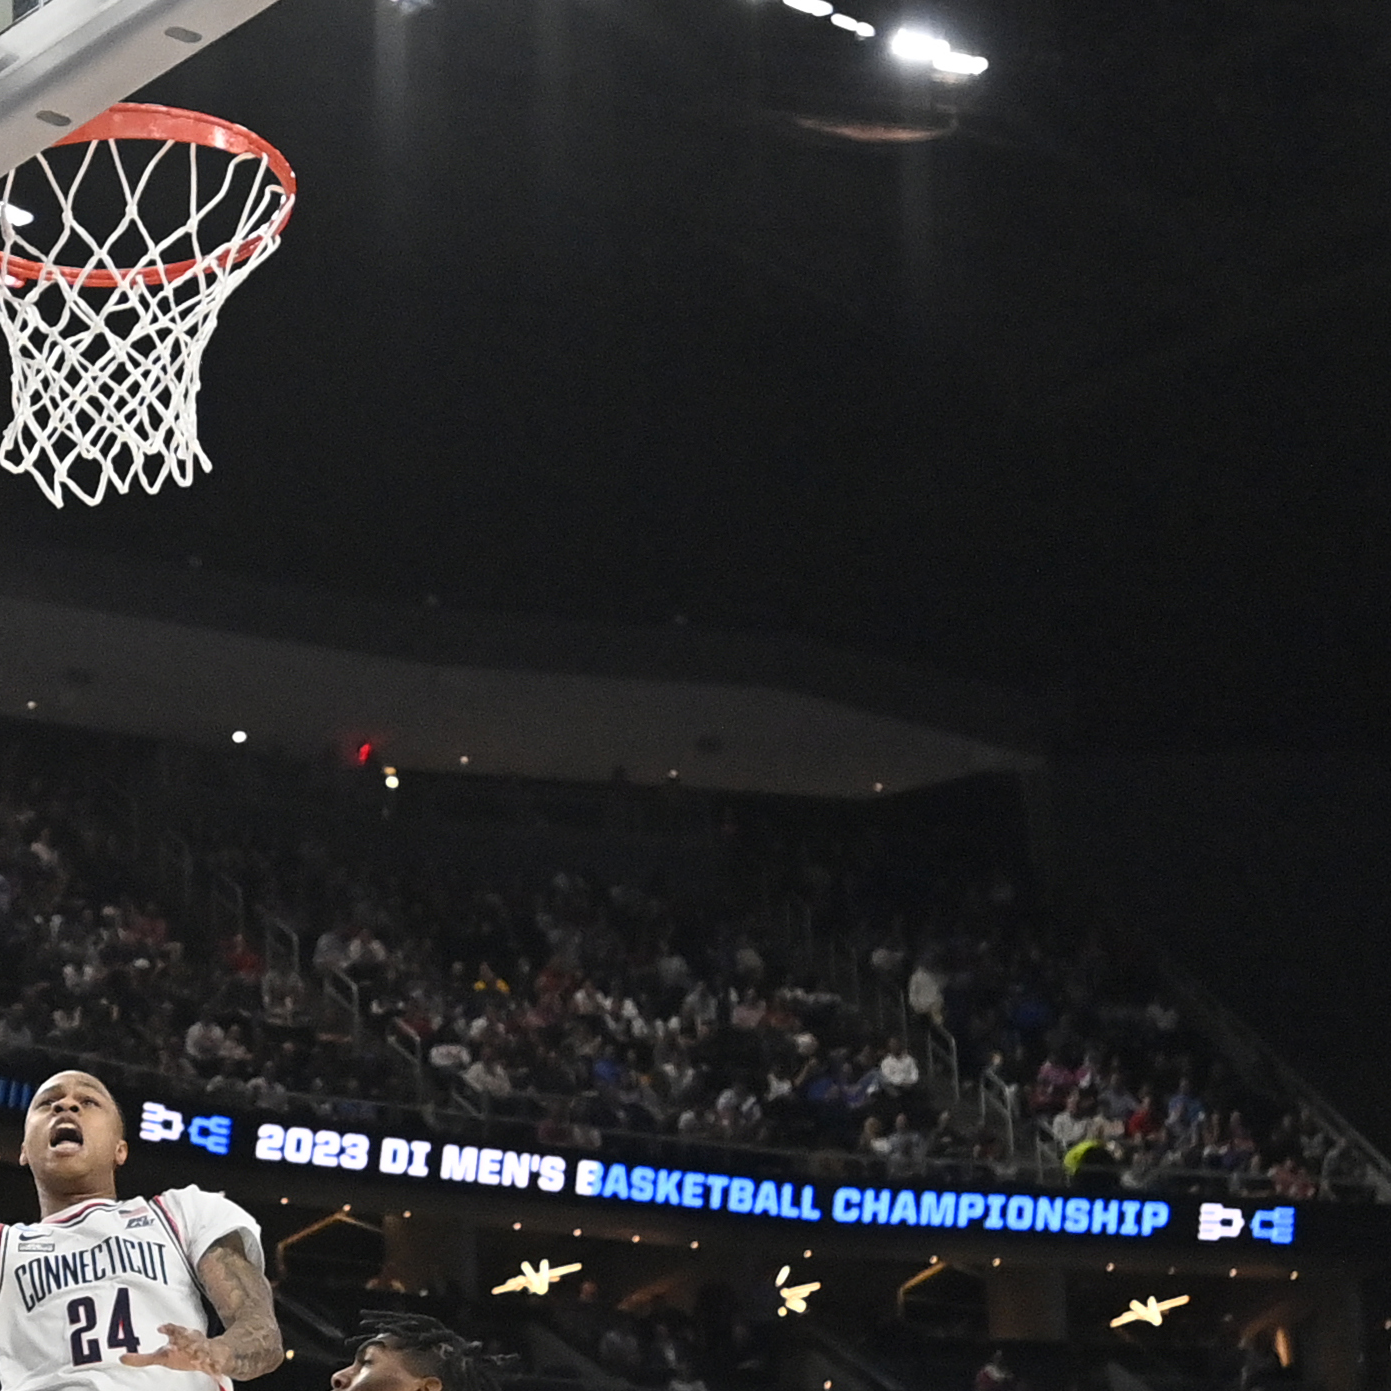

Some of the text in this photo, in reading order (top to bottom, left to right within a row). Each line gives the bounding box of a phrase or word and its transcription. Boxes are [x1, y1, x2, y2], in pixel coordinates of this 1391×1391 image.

[256, 1123, 1169, 1236] 2023 DI MEN'S BASKETBALL CHAMPIONSHIP
[14, 1235, 168, 1313] CONNECTICUT
[66, 1287, 140, 1367] 24
